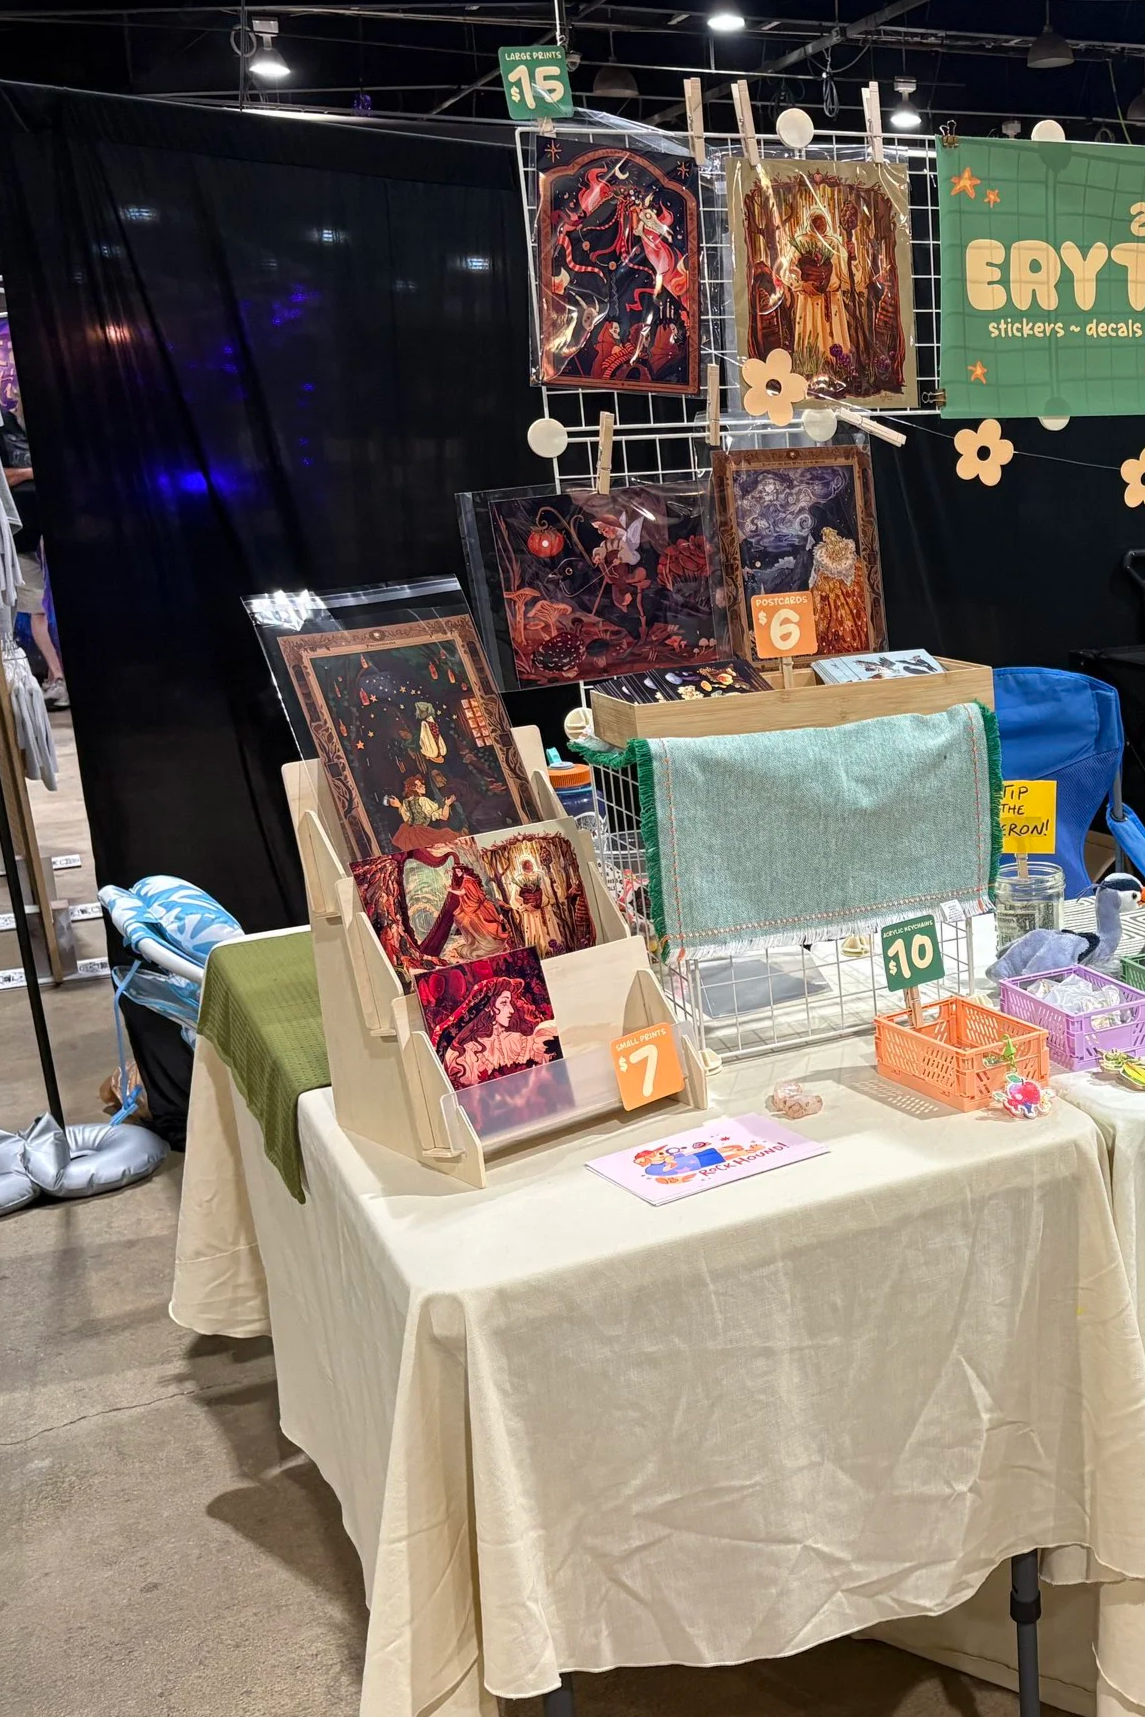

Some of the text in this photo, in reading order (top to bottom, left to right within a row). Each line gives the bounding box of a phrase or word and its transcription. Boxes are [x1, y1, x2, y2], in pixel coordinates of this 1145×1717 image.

[504, 51, 562, 61] LARGE PRINTS
[507, 64, 565, 109] $15
[988, 317, 1065, 338] stickers
[1085, 318, 1143, 338] decals
[755, 595, 808, 607] POSTCARDS
[757, 608, 801, 651] $6
[1003, 784, 1029, 801] TIP
[1001, 803, 1025, 816] THE
[1001, 818, 1050, 837] ERON!
[882, 919, 934, 939] ACRYLIC KEYCHAINS
[887, 933, 934, 979] $10
[615, 1027, 668, 1052] SMALL PRINTS
[618, 1043, 659, 1098] $7
[732, 1141, 790, 1166] HOUND!
